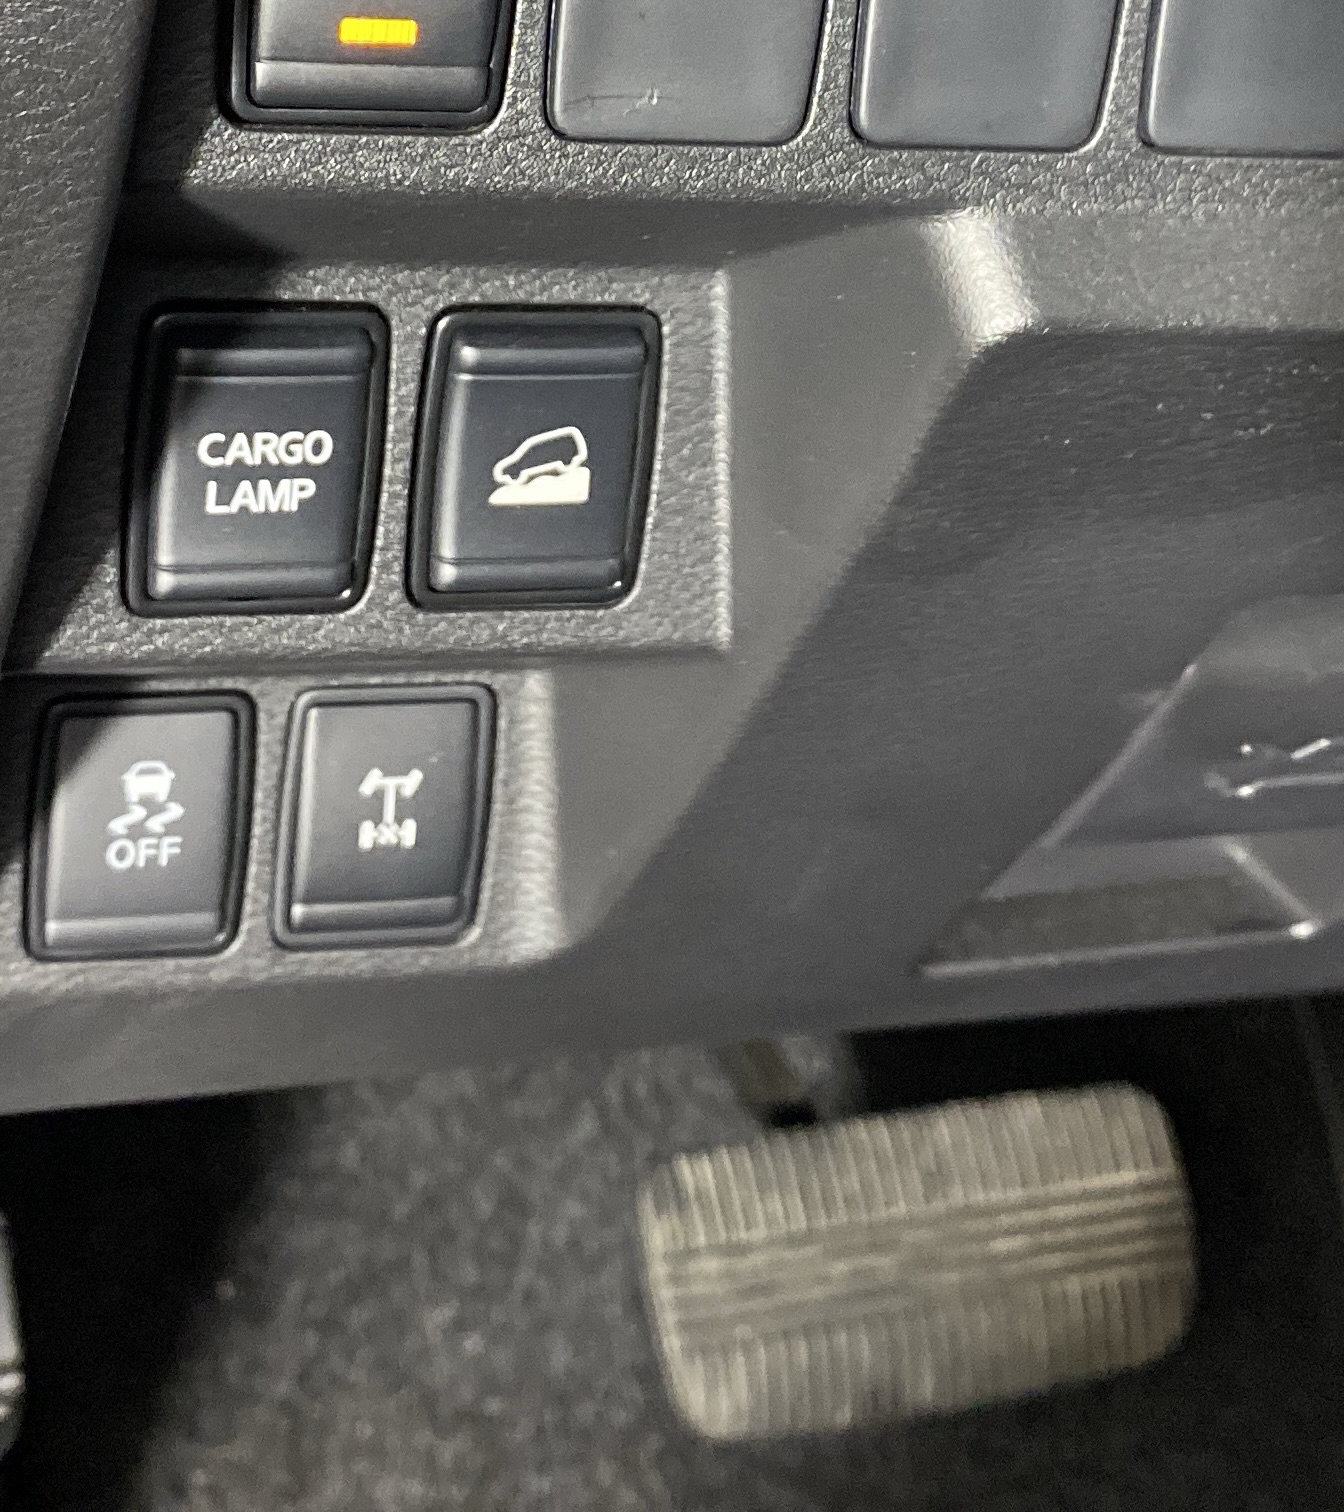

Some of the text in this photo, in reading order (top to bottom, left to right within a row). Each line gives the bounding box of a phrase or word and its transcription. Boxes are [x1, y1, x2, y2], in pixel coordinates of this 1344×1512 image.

[197, 430, 334, 468] CARGO
[205, 478, 317, 515] LAMP
[105, 836, 183, 870] OFF
